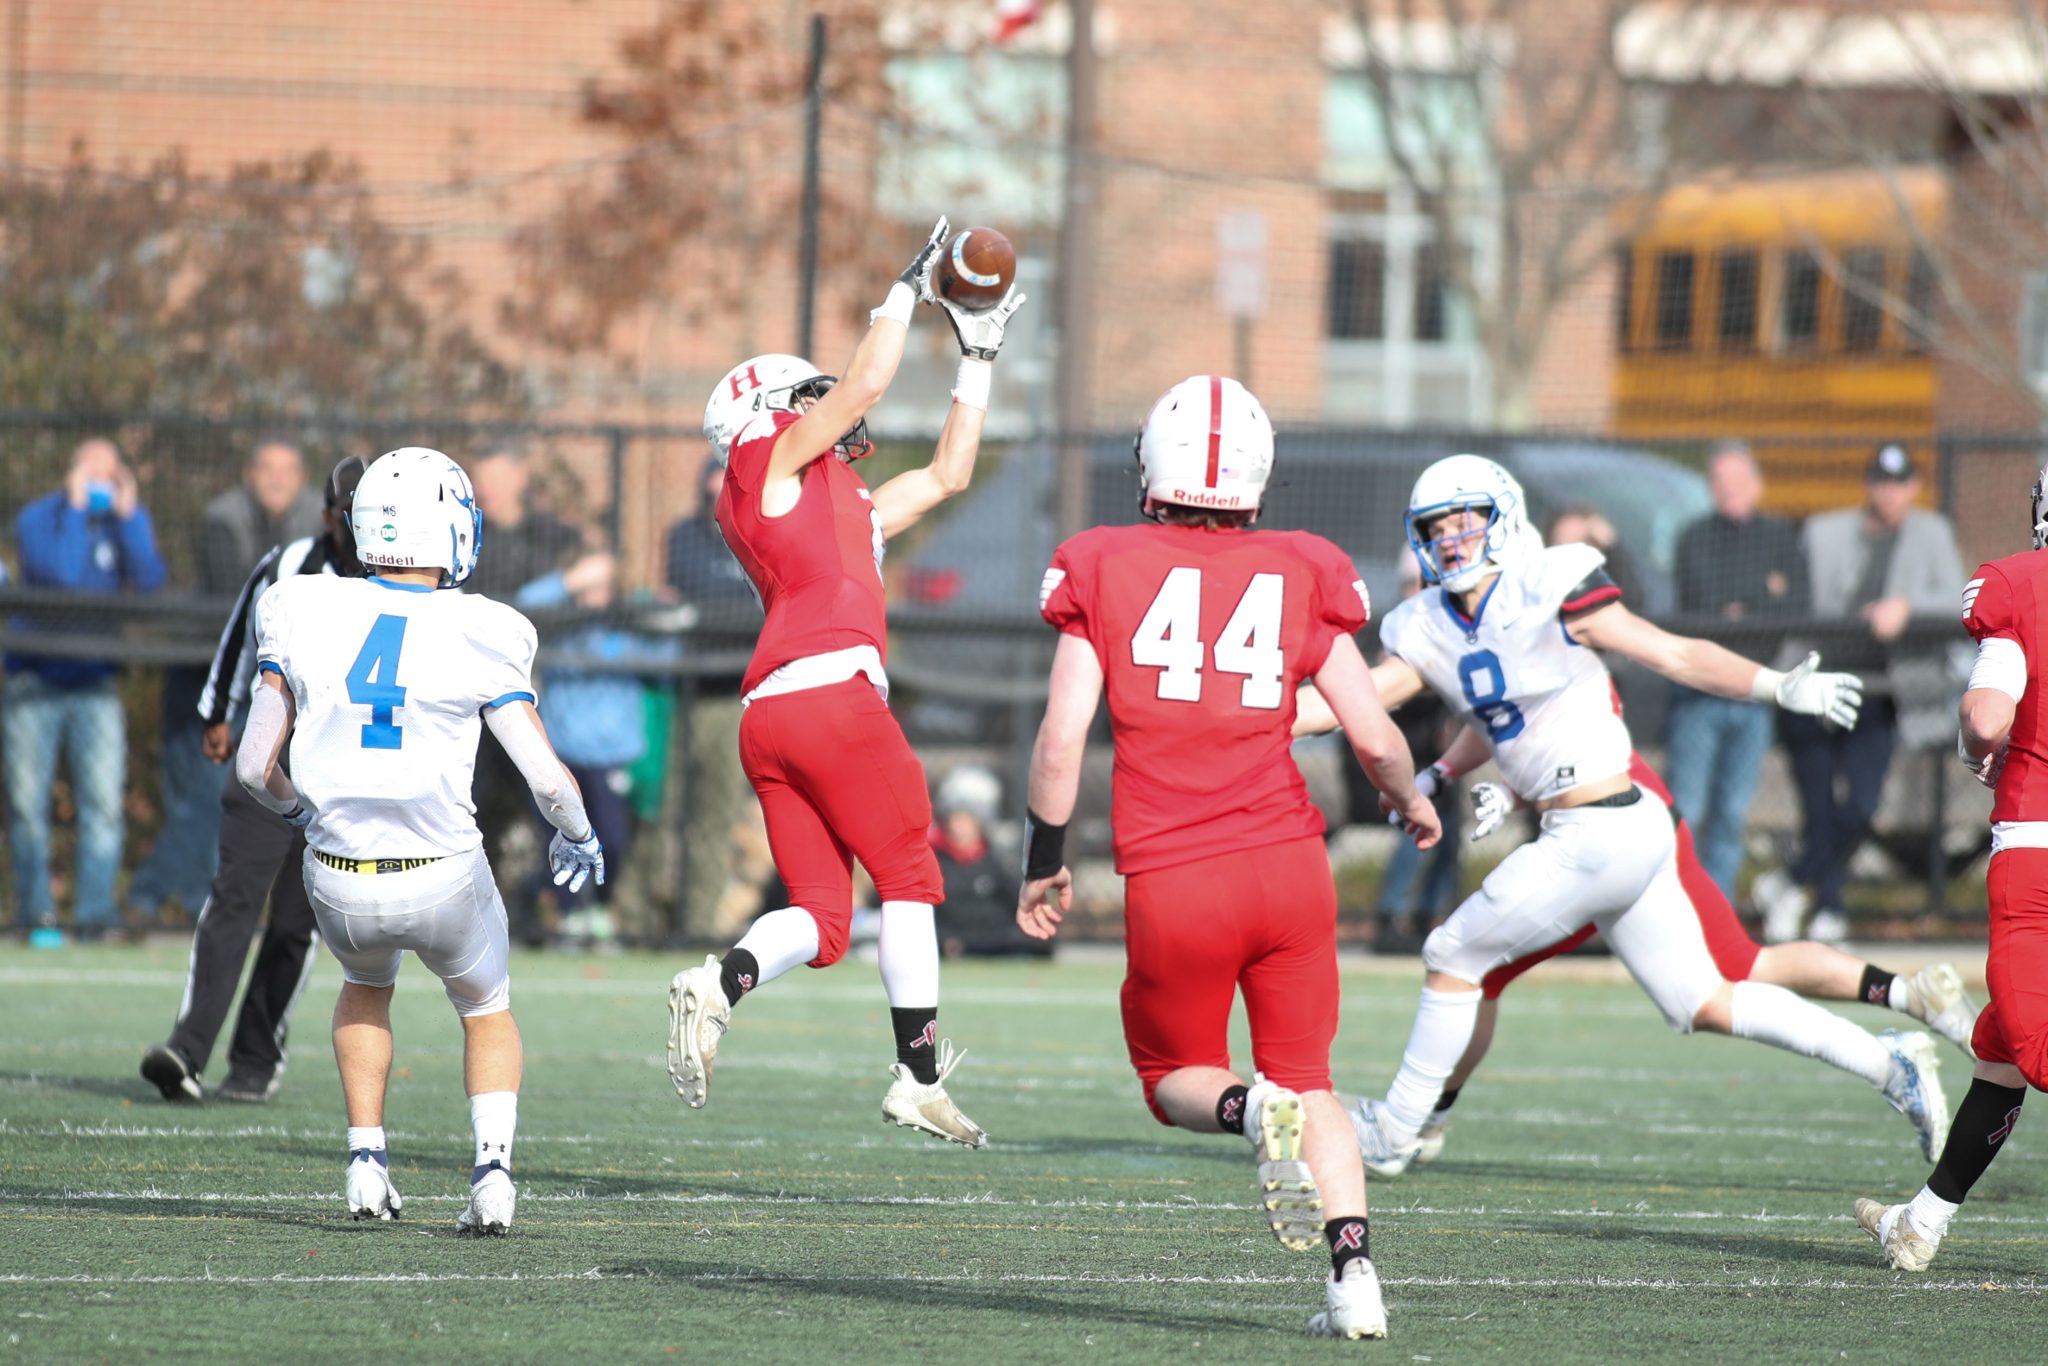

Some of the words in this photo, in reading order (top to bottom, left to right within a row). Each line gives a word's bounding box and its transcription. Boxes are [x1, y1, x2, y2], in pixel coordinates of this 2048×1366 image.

[729, 363, 762, 401] H
[1173, 489, 1240, 507] Riddell
[366, 552, 414, 566] Riddell
[1130, 566, 1284, 710] 44
[345, 613, 408, 750] 4
[1458, 648, 1525, 744] 8
